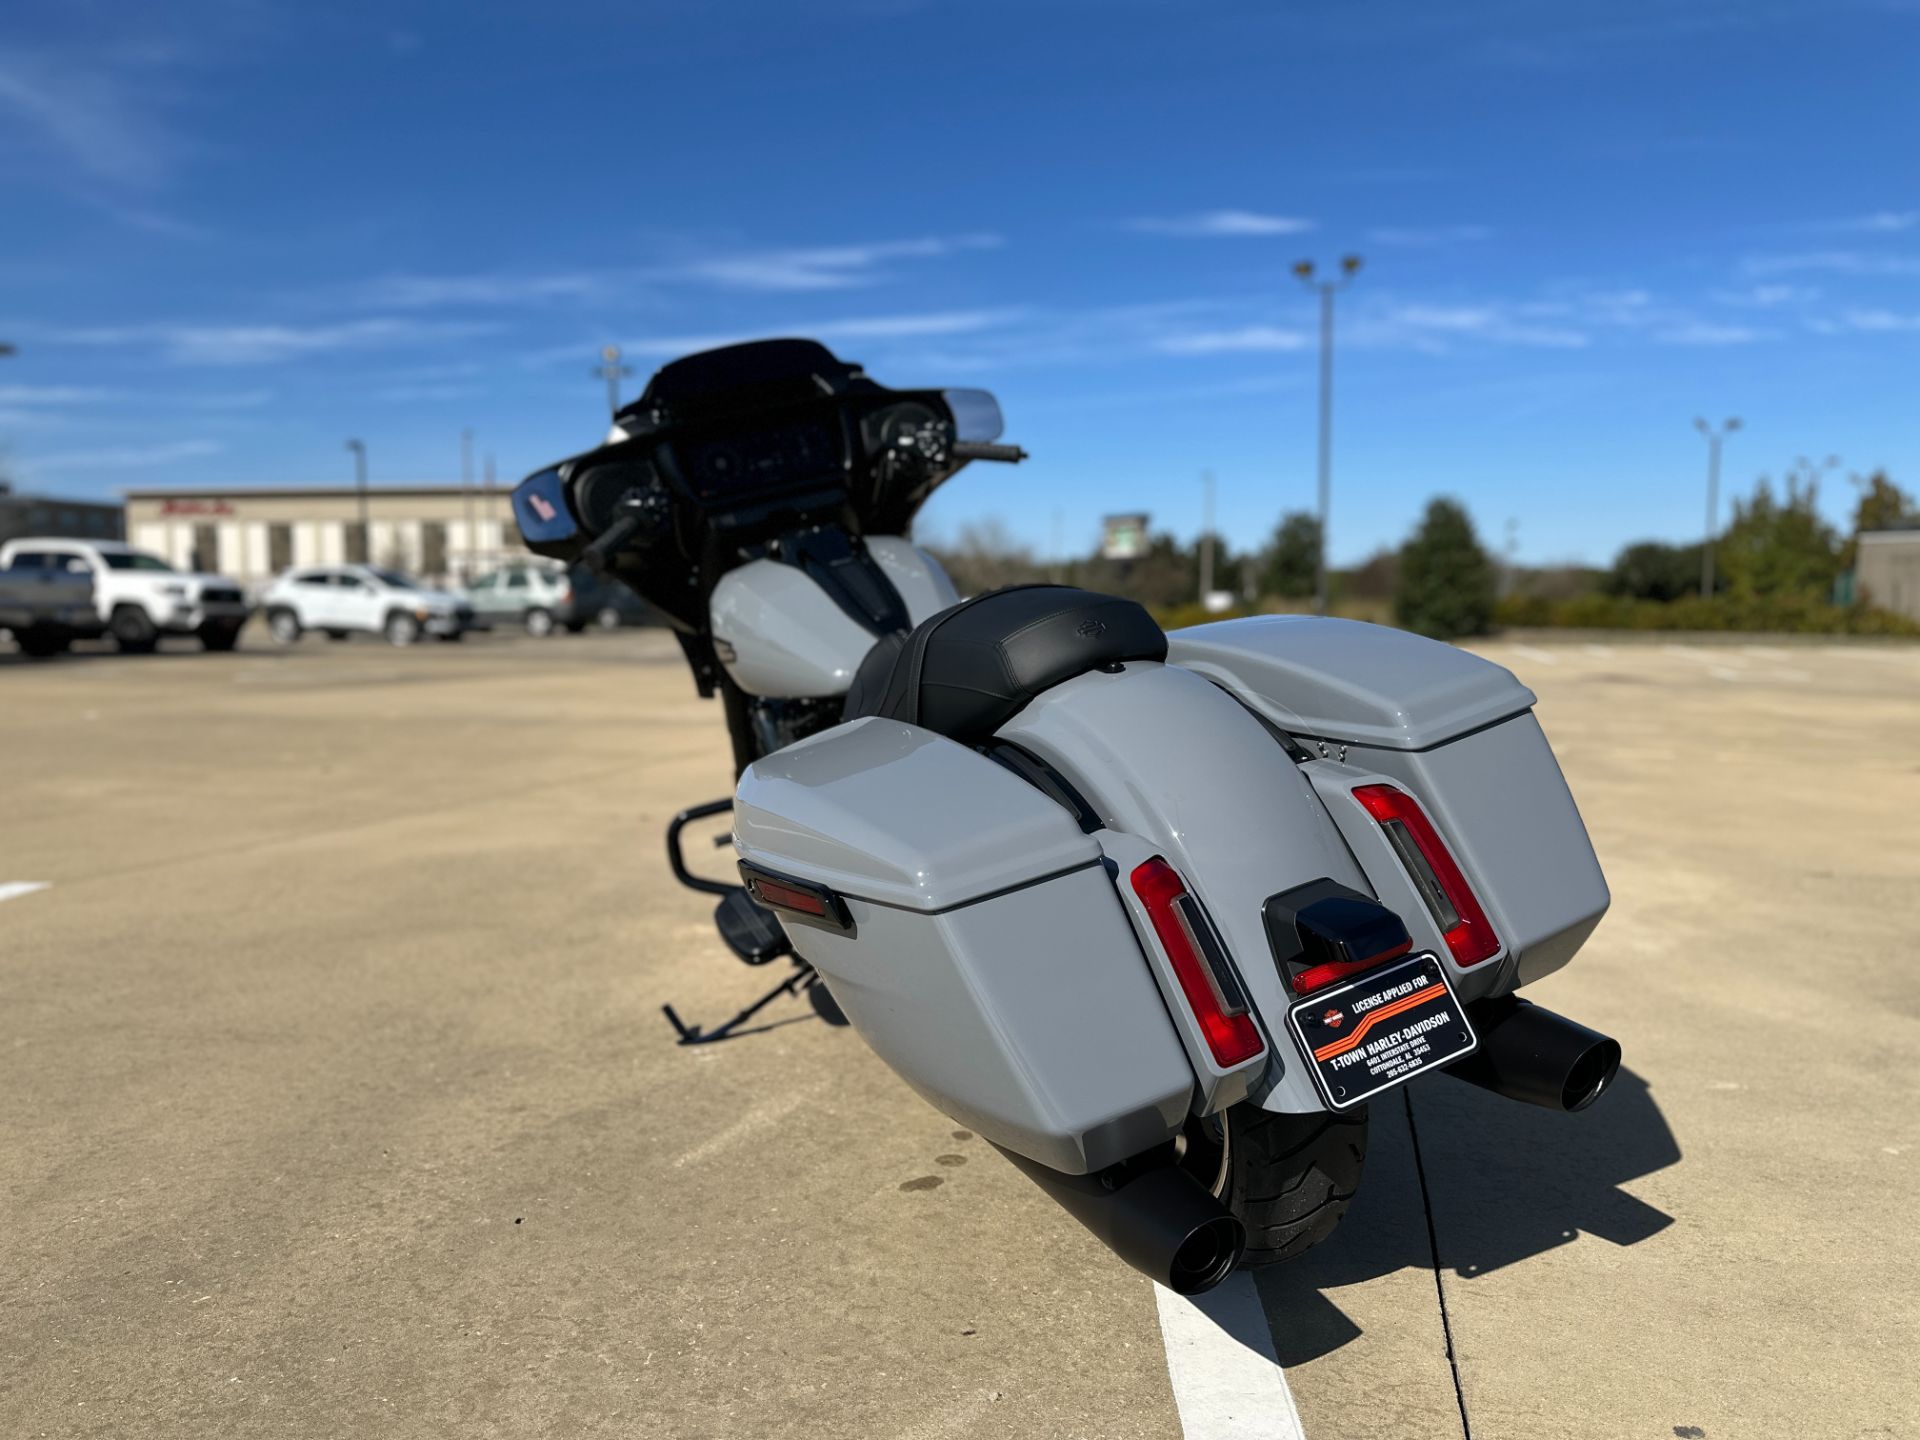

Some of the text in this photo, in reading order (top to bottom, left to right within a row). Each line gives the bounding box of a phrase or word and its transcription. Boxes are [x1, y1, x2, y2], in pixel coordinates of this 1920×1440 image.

[1352, 975, 1429, 1014] LICENSE APPLIED FOR
[1330, 1047, 1367, 1071] T-TOWN
[1366, 1011, 1450, 1056] HARLEY-DAVIDSON
[1380, 1044, 1410, 1062] INTERSTATE
[1410, 1036, 1427, 1048] DRIVE
[1405, 1053, 1413, 1062] AL
